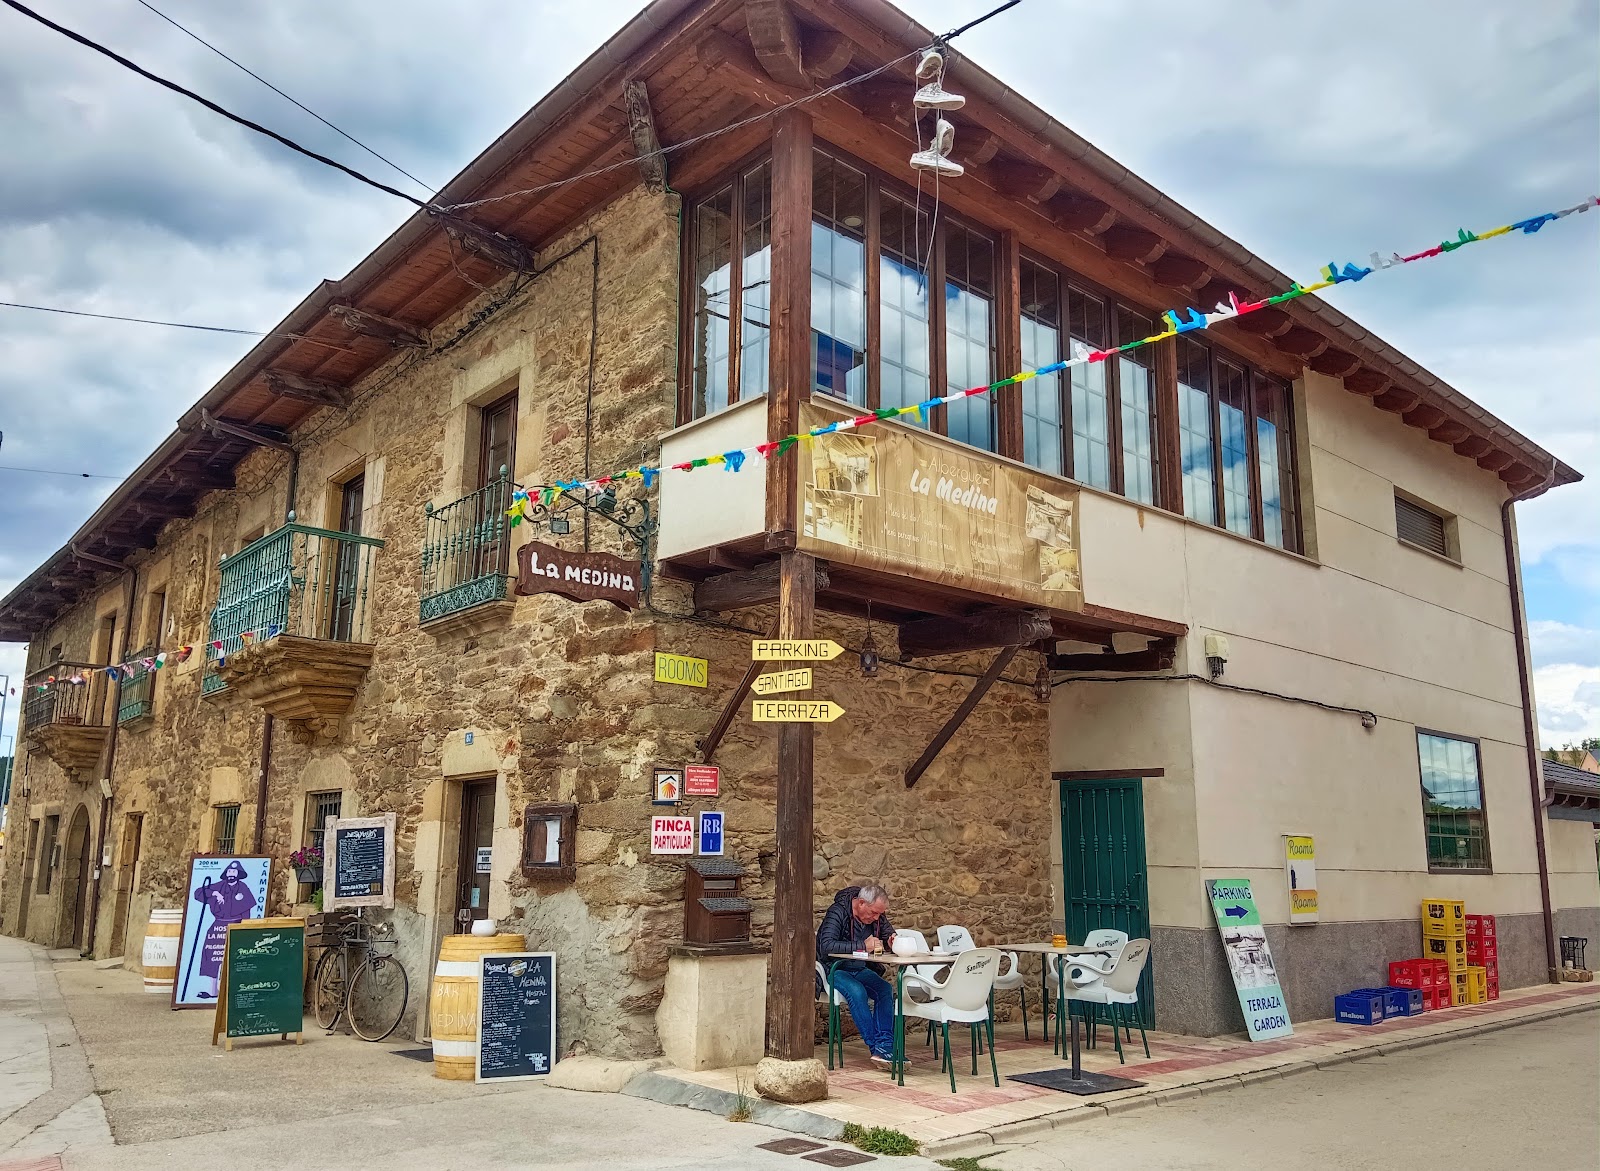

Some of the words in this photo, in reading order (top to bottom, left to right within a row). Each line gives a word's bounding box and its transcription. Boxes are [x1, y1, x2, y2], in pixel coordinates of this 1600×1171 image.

[928, 457, 982, 485] Albergue
[910, 469, 931, 497] La
[936, 477, 999, 515] Medina
[531, 552, 560, 579] La
[757, 643, 829, 658] PARKING
[658, 656, 705, 684] ROOMS
[758, 671, 809, 692] SANTIAGO
[756, 703, 829, 719] TERRAZA
[655, 820, 692, 832] FINCA
[703, 818, 720, 834] RB
[654, 835, 692, 850] PARTICULAR
[1288, 839, 1315, 856] Rooms
[257, 861, 268, 919] CAMPONA
[1212, 887, 1252, 900] PARKING
[1292, 893, 1318, 910] Rooms
[437, 984, 459, 998] BAR
[1247, 996, 1282, 1012] TERRAZA
[1253, 1015, 1286, 1032] GARDEN
[1340, 1011, 1365, 1020] Mahou
